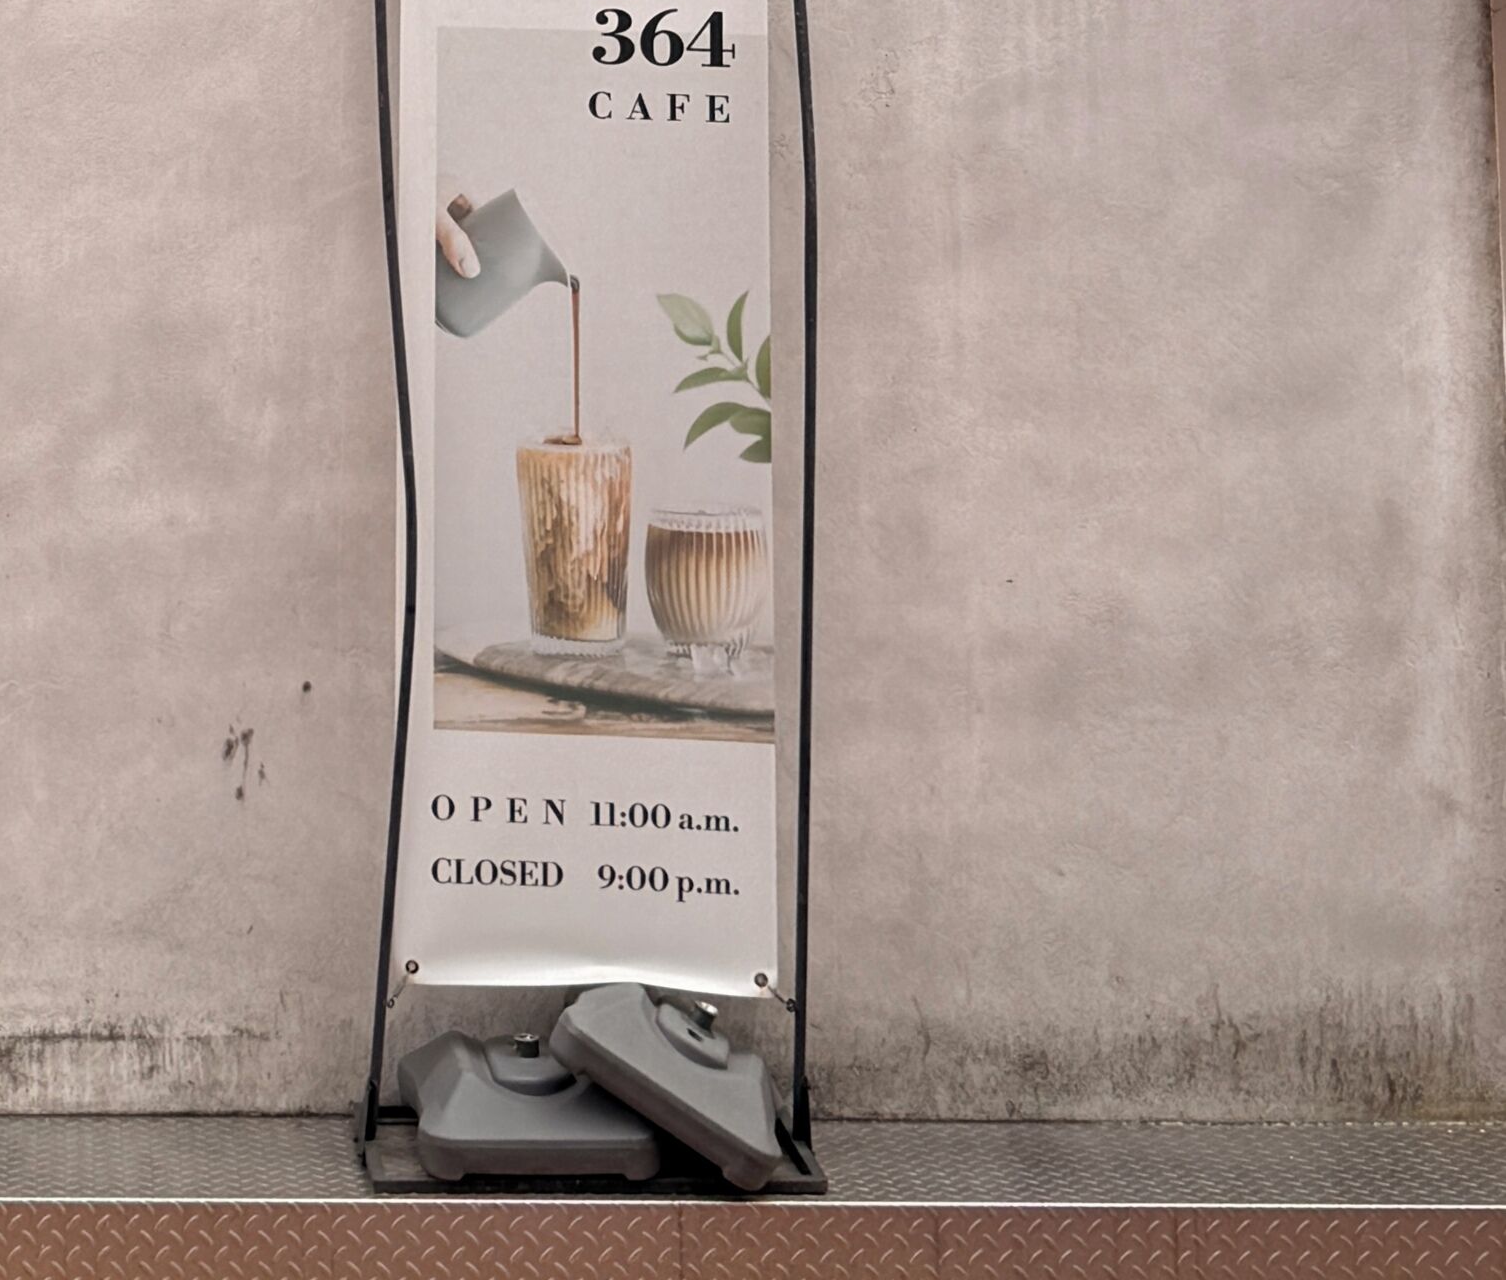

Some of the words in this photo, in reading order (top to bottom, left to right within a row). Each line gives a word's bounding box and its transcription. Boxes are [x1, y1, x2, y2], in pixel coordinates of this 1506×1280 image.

[592, 8, 736, 68] 364
[588, 91, 730, 123] CAFE
[431, 794, 567, 826] OPEN
[590, 801, 672, 829] 11:00
[678, 811, 740, 833] a.m.
[431, 857, 564, 888] CLOSED
[597, 864, 670, 892] 9:00
[675, 875, 740, 903] p.m.
